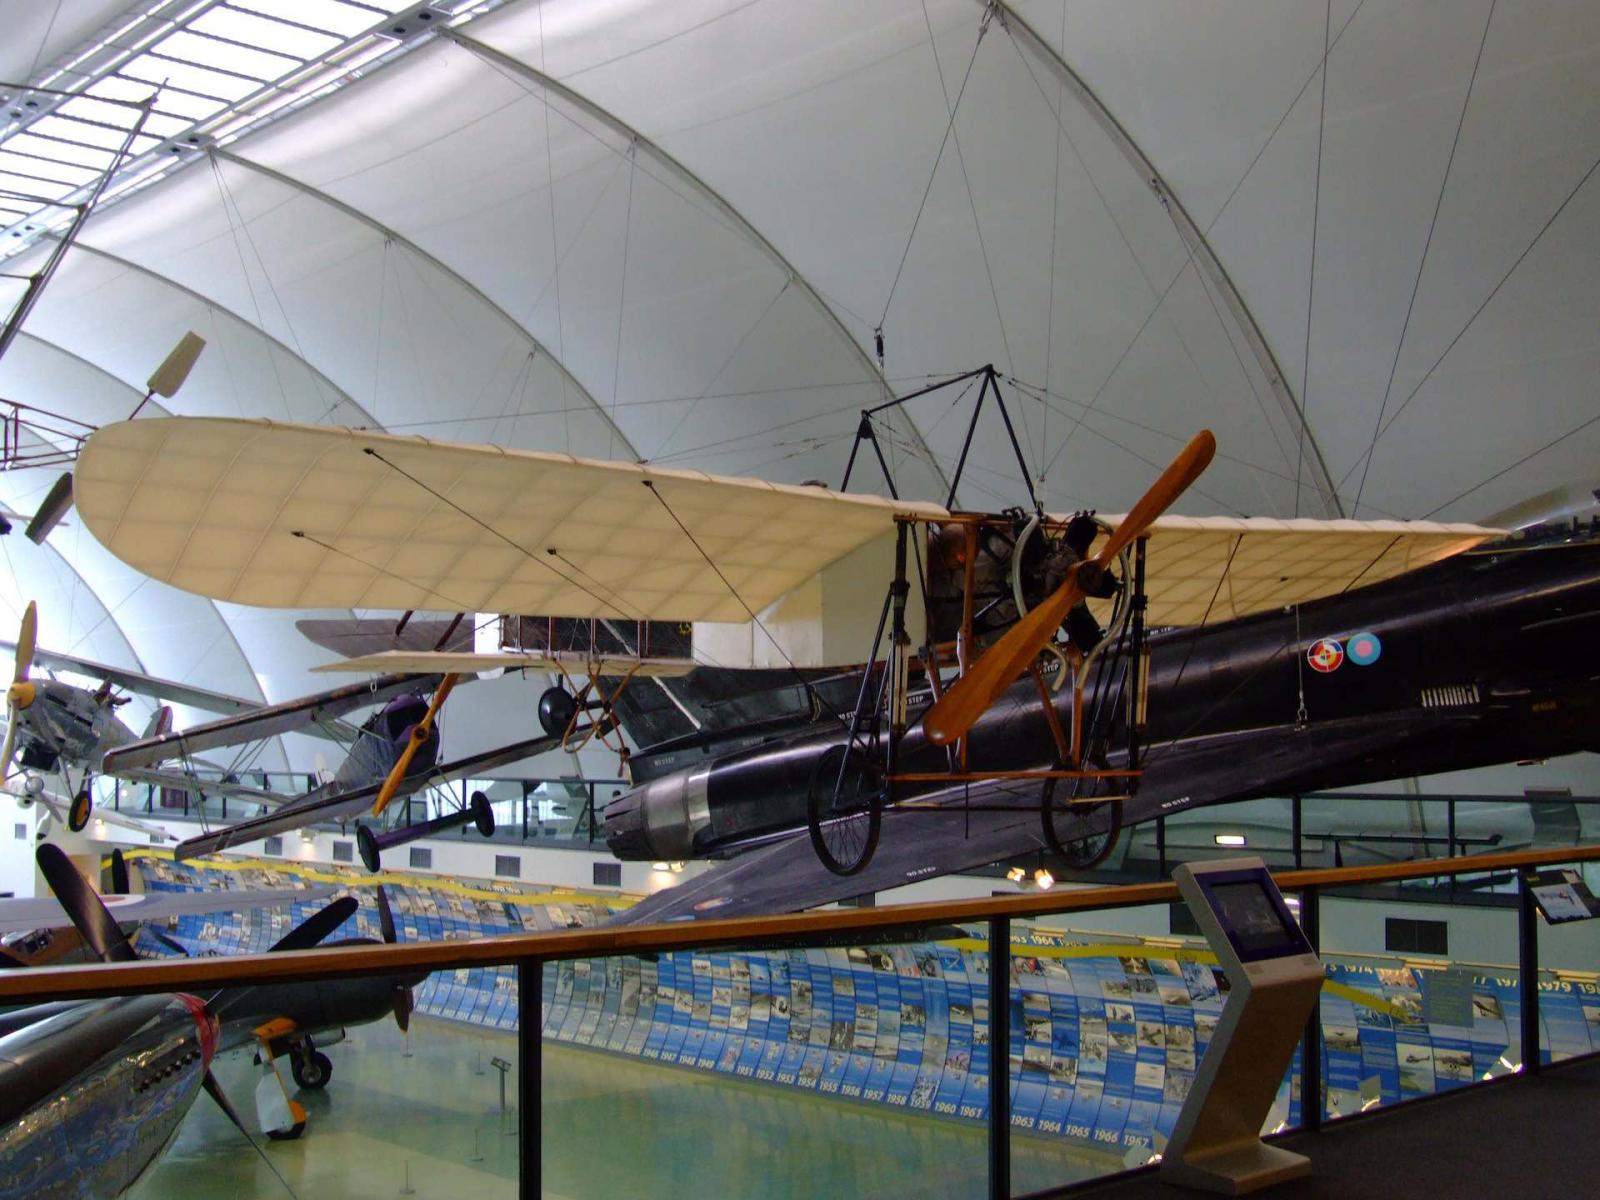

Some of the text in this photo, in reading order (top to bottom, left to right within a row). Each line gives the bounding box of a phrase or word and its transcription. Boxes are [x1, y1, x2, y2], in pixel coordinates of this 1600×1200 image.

[908, 695, 924, 705] STEP
[660, 1051, 677, 1061] 1947
[679, 1055, 696, 1065] 1948
[698, 1058, 715, 1069] 1949
[737, 1065, 754, 1076] 1951
[756, 1069, 775, 1080] 1952
[776, 1072, 795, 1084] 1953
[797, 1076, 817, 1088] 1954
[819, 1080, 839, 1092] 1955
[841, 1084, 861, 1096] 1956
[863, 1089, 884, 1101] 1957
[886, 1093, 907, 1105] 1958
[910, 1097, 932, 1109] 1959
[934, 1101, 957, 1114] 1960
[960, 1105, 983, 1118] 1961
[1010, 1114, 1149, 1147] 1963 1964 1965 1966 1967
